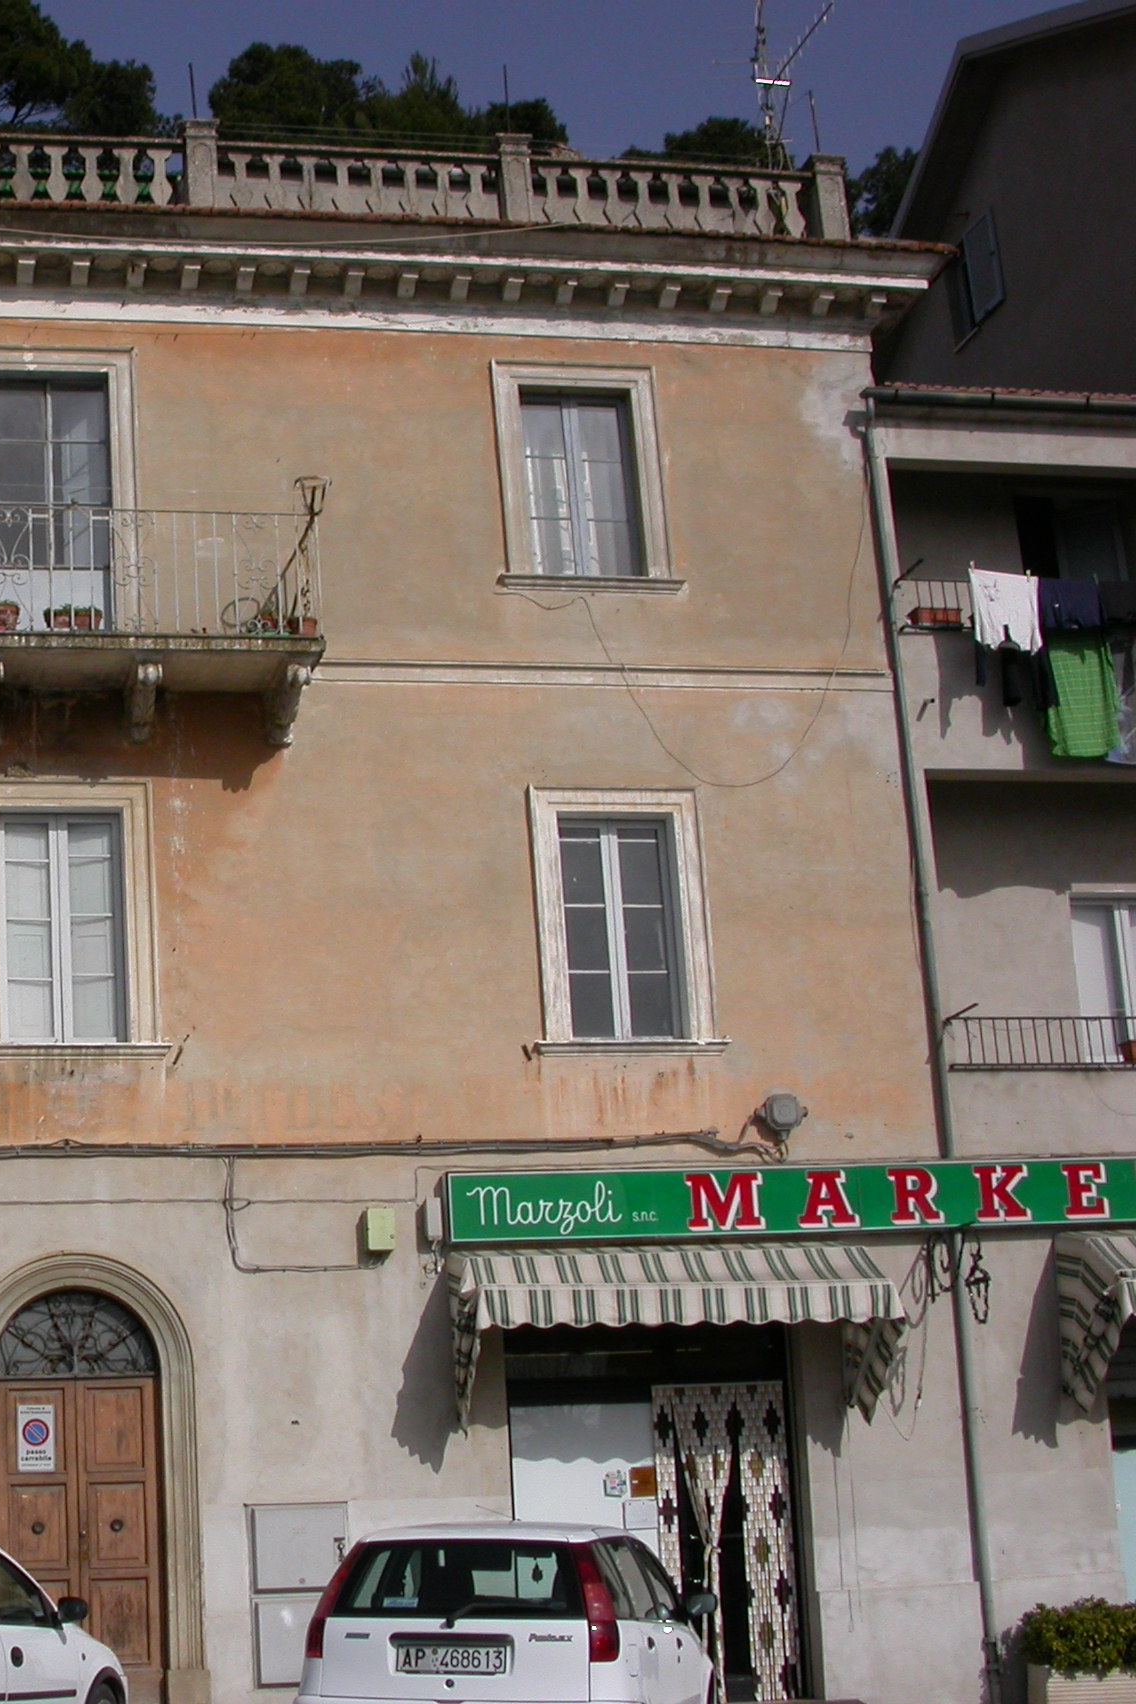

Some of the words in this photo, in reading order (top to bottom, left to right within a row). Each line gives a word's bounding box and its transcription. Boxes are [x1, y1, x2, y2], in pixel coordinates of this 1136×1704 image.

[465, 1180, 624, 1235] Marzoli
[683, 1161, 1136, 1231] MARKE
[401, 1648, 427, 1669] AP
[438, 1648, 504, 1670] 468613
